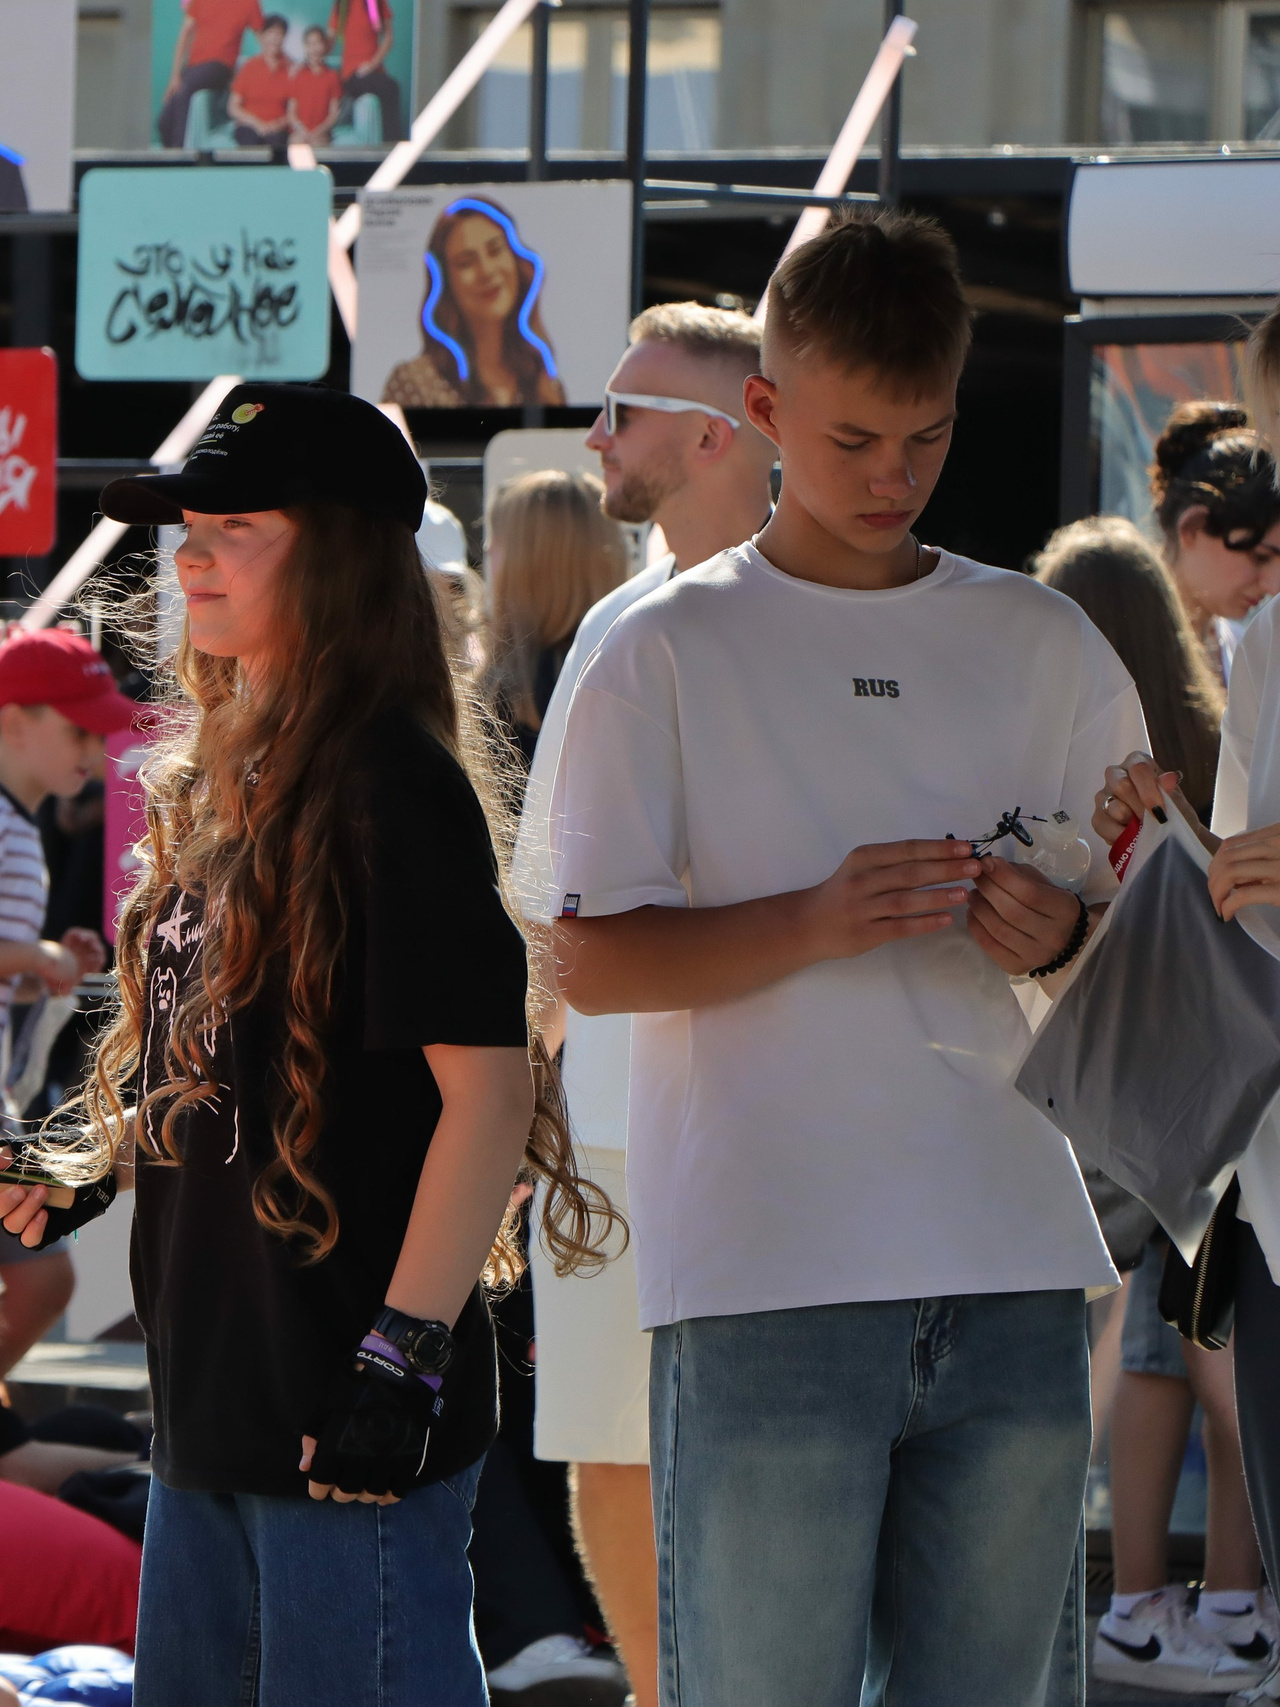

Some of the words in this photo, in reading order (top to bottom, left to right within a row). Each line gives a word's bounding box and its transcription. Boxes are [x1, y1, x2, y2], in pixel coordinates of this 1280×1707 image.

[852, 678, 900, 699] RUS
[95, 1186, 111, 1204] GEL
[356, 1351, 405, 1377] CORTO
